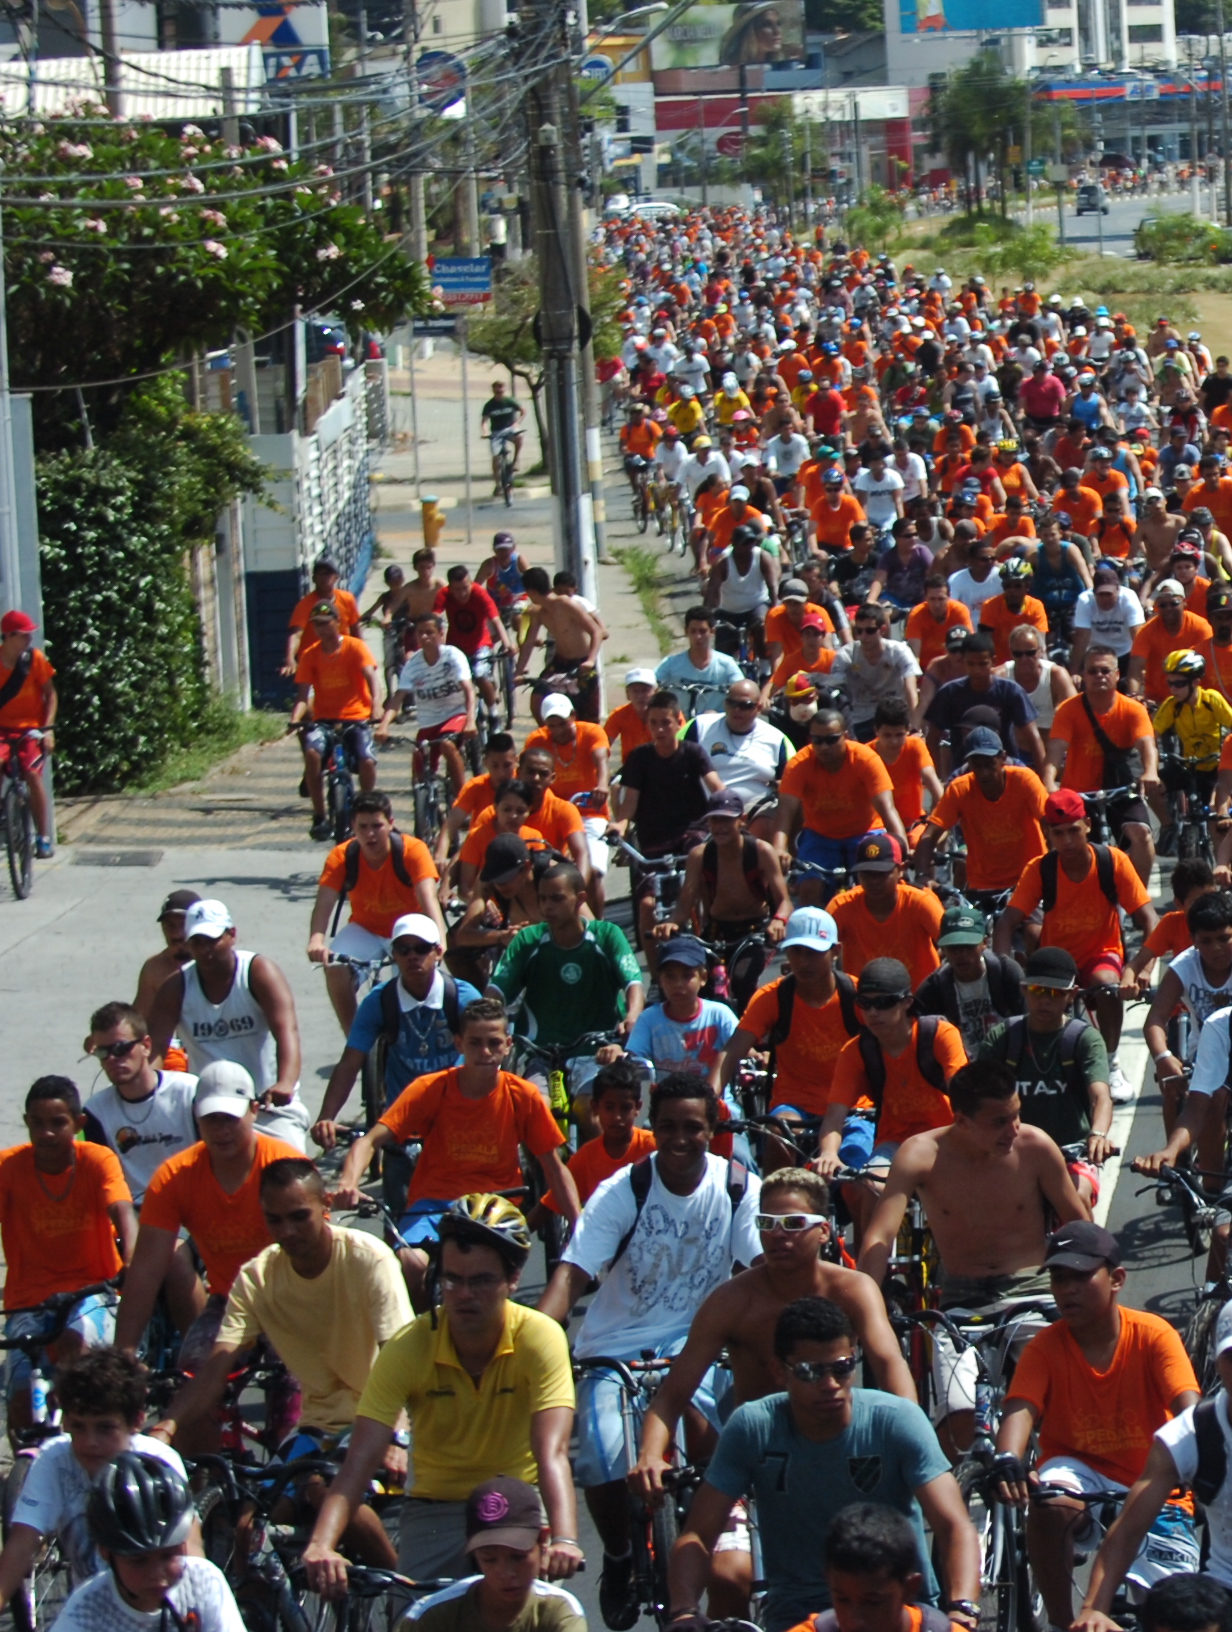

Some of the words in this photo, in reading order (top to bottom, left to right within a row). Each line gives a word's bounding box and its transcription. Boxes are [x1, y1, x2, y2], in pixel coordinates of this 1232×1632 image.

[266, 54, 322, 78] IXA
[1086, 1425, 1145, 1444] PEDALA
[759, 1452, 790, 1495] 7
